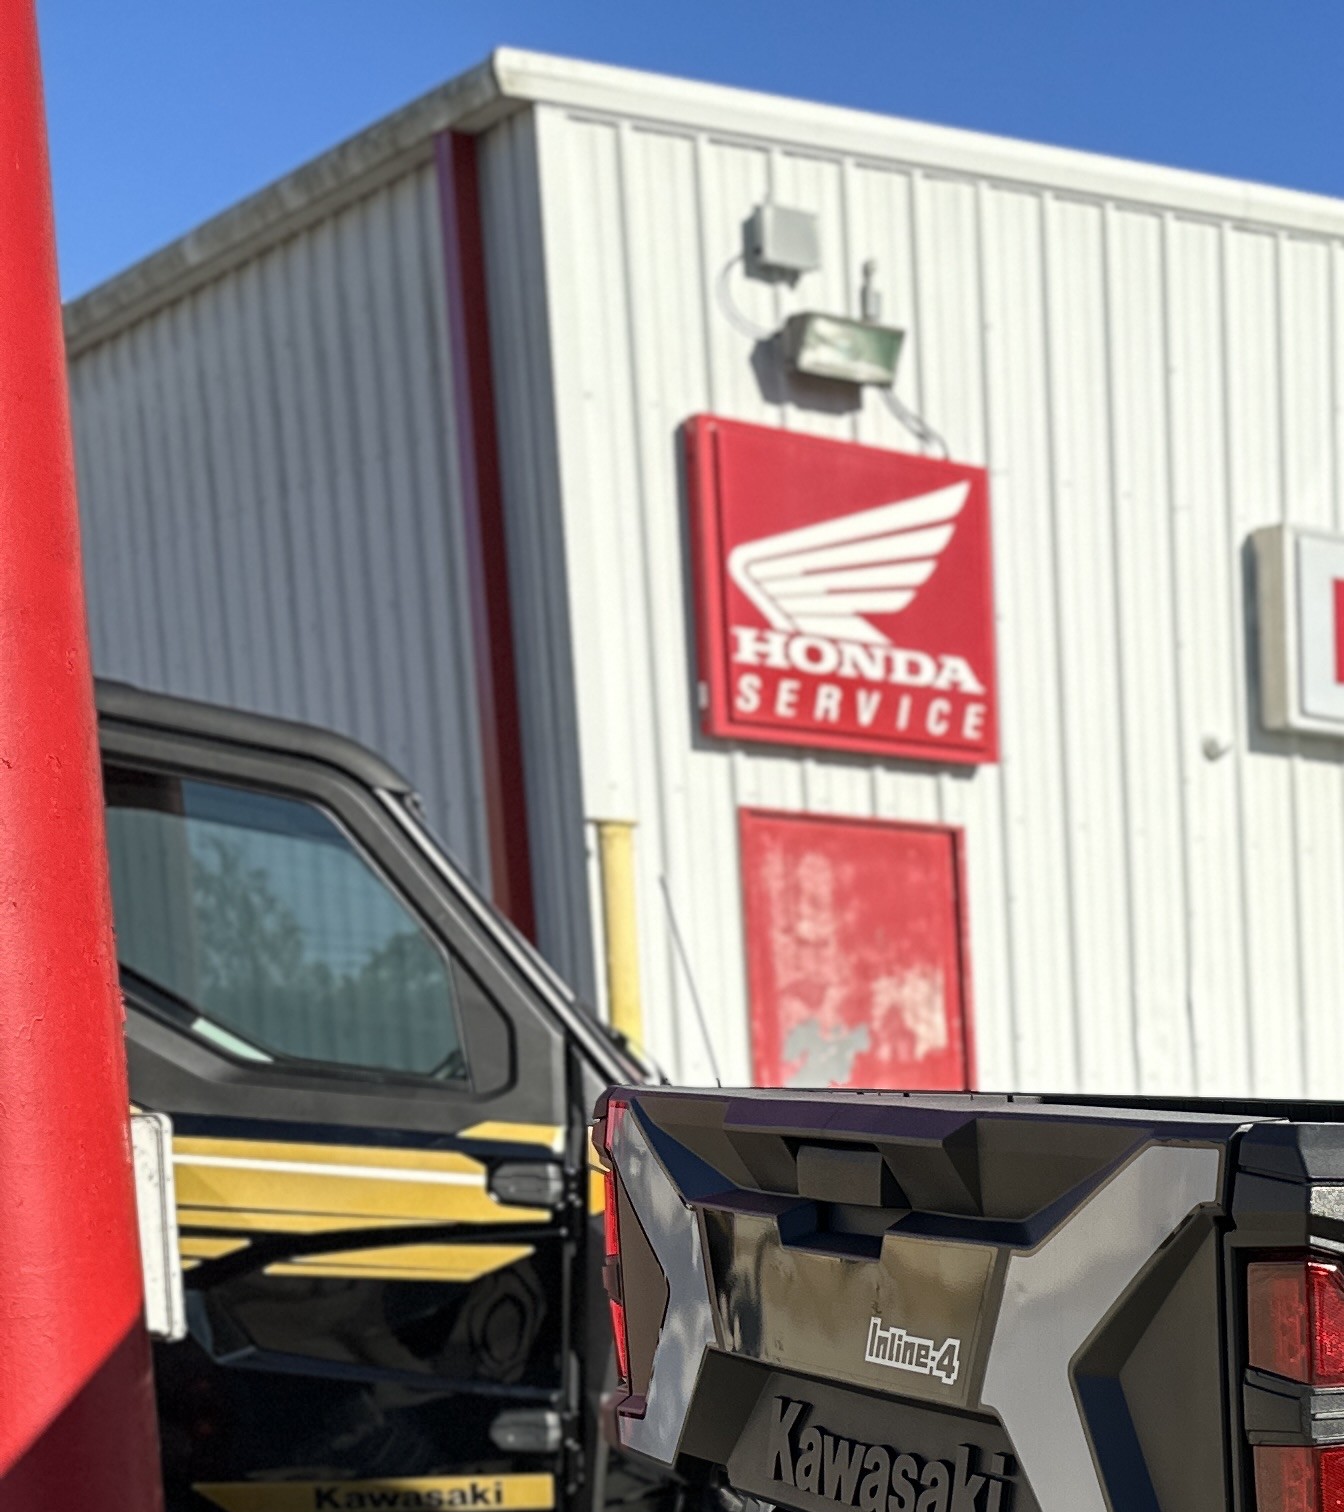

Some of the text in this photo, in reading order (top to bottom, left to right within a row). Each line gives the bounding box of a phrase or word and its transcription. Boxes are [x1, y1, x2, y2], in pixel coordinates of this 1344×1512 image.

[731, 626, 986, 695] HONDA
[735, 673, 986, 741] SERVICE
[865, 1317, 960, 1384] Inline-4
[315, 1482, 504, 1510] Kawasaki
